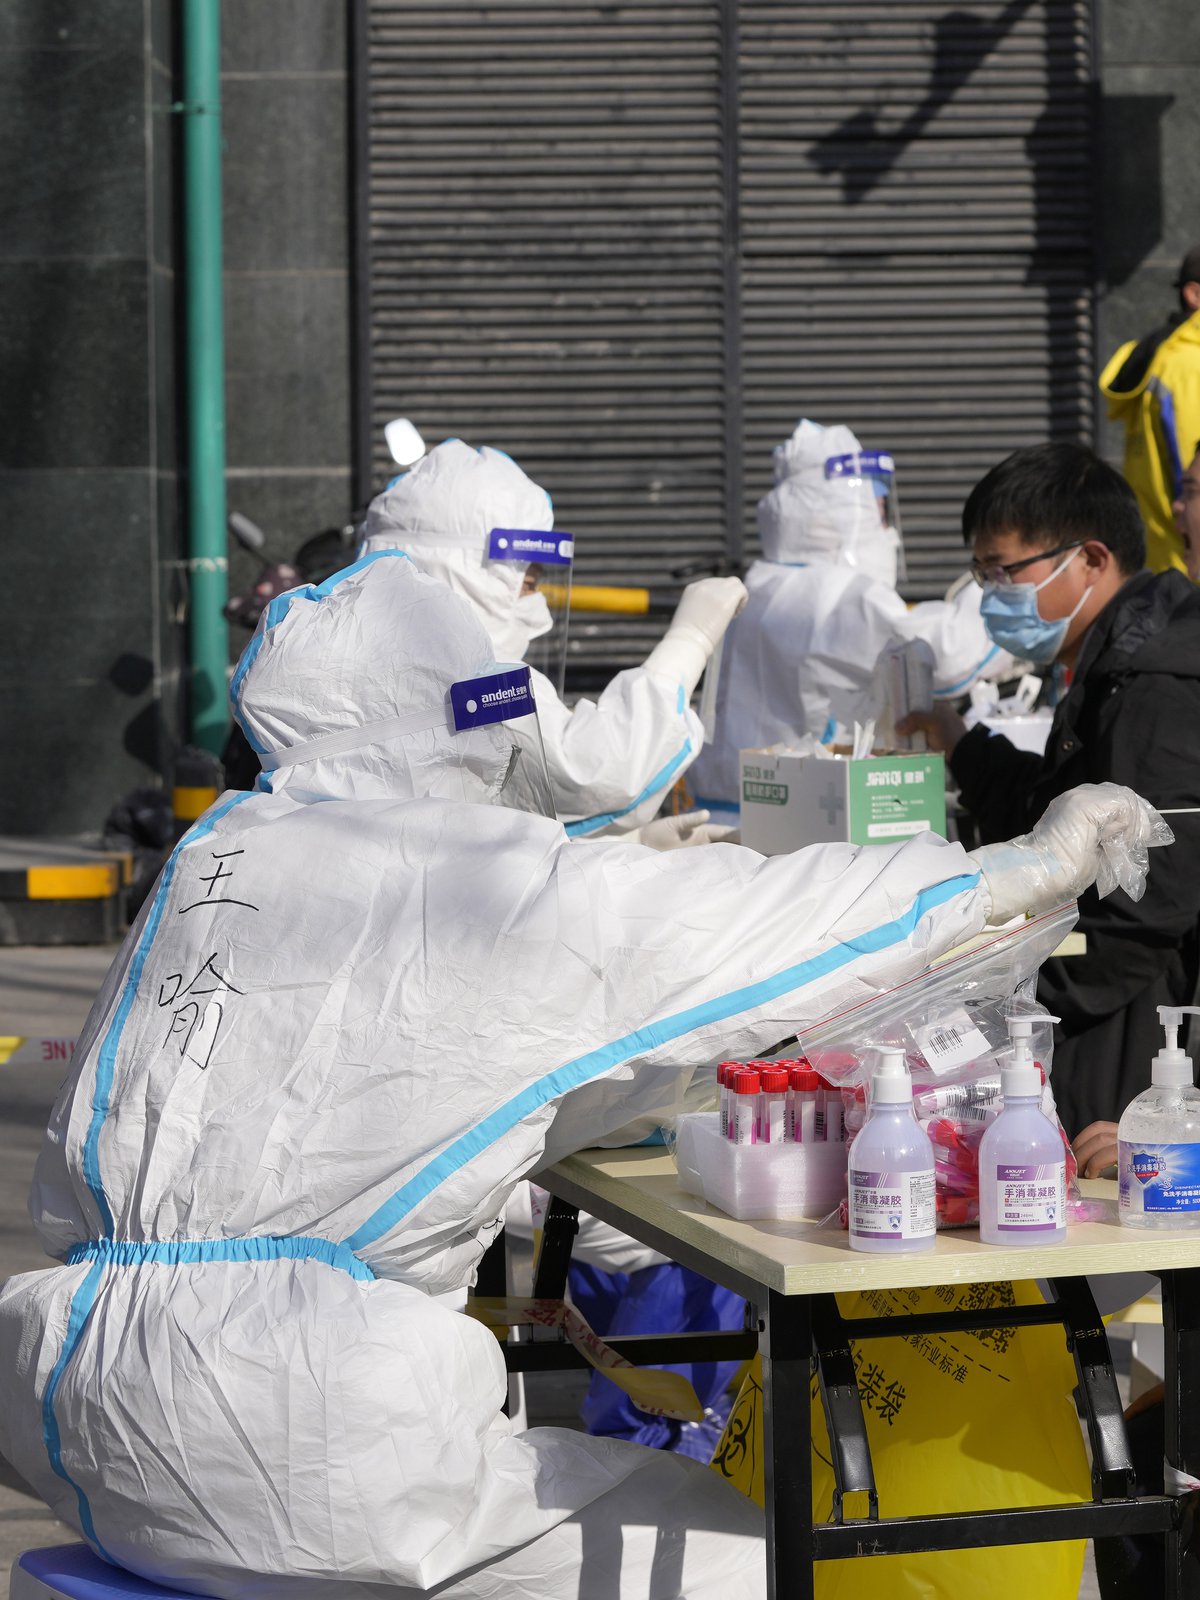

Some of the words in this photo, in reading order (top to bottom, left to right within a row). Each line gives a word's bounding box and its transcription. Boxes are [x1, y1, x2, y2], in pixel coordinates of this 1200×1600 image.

[481, 685, 517, 704] andent
[853, 1193, 902, 1206] 手消毒凝胶
[1004, 1187, 1056, 1199] 手消毒凝胶
[901, 1333, 969, 1384] 家行业标准
